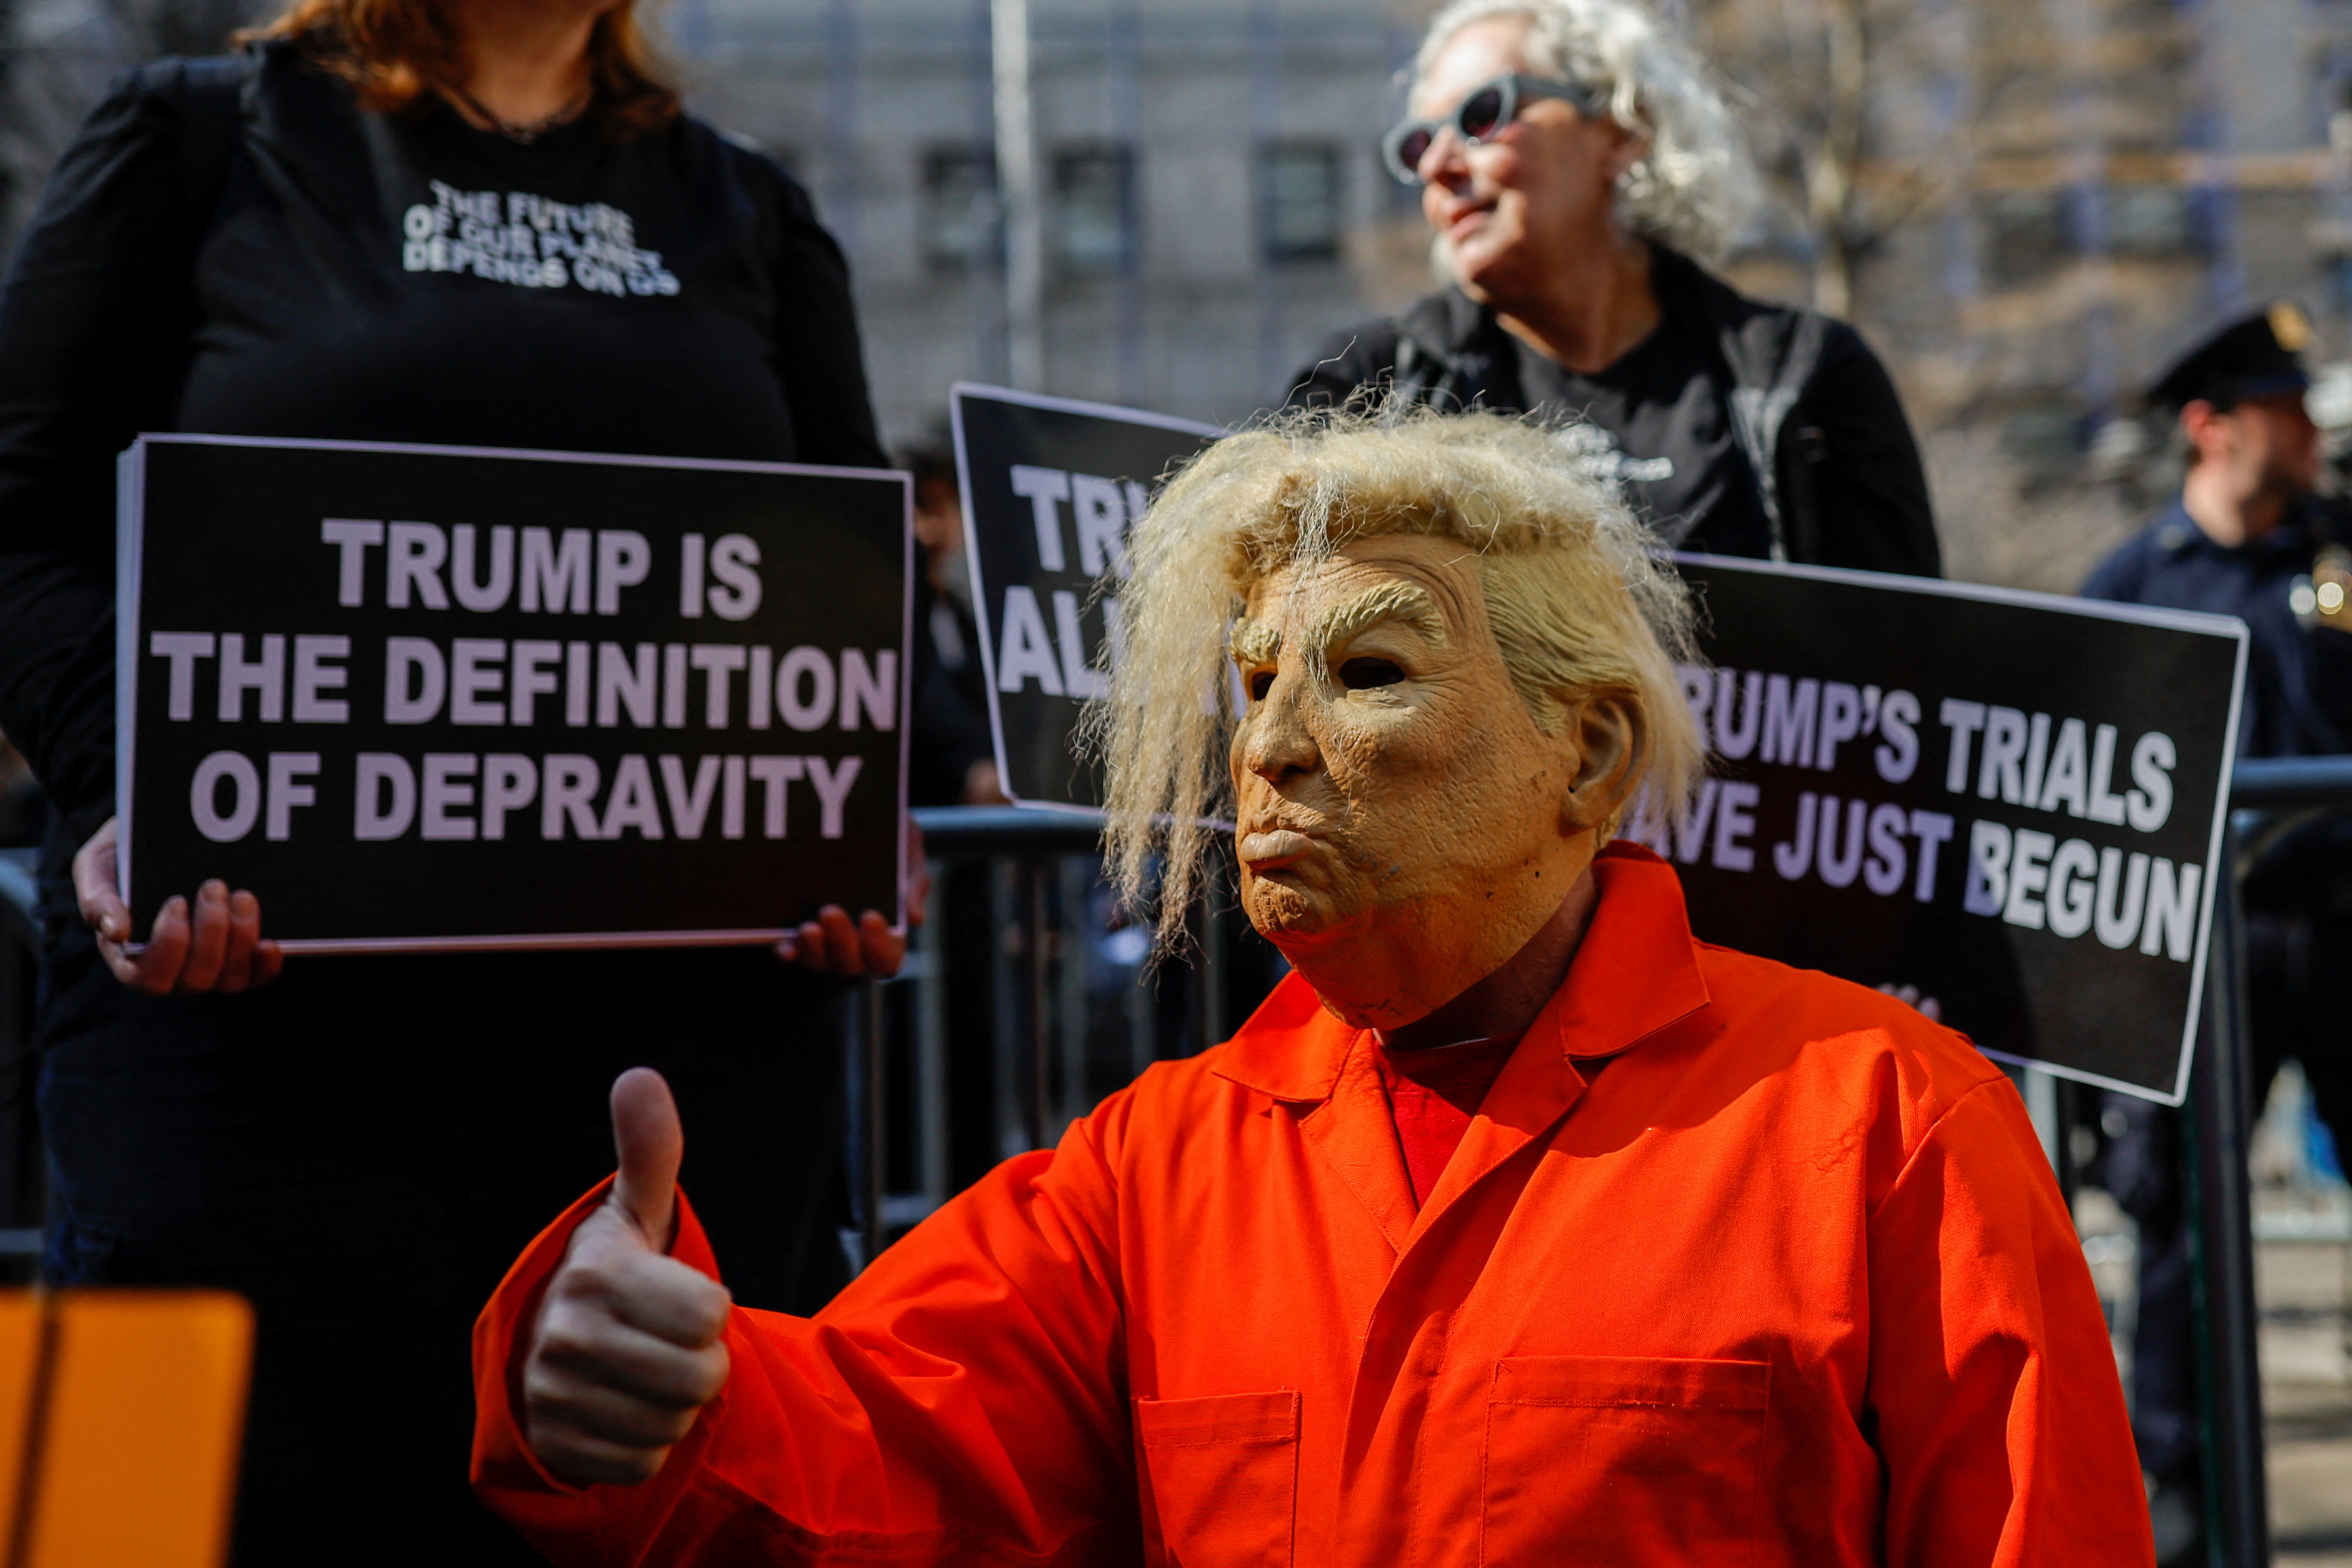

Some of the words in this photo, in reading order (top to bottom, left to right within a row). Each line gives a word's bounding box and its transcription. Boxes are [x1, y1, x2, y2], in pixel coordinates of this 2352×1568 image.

[429, 178, 502, 227] THE
[321, 518, 651, 615] TRUMP
[680, 533, 762, 621] IS
[150, 631, 350, 723] THE
[384, 636, 897, 731] DEFINITION
[190, 750, 321, 842] OF
[354, 753, 862, 840] DEPRAVITY
[1675, 662, 1921, 783] RUMP'S
[1939, 697, 2177, 834] TRIALS
[1773, 791, 1954, 903] JUST
[1964, 819, 2203, 963] BEGUN
